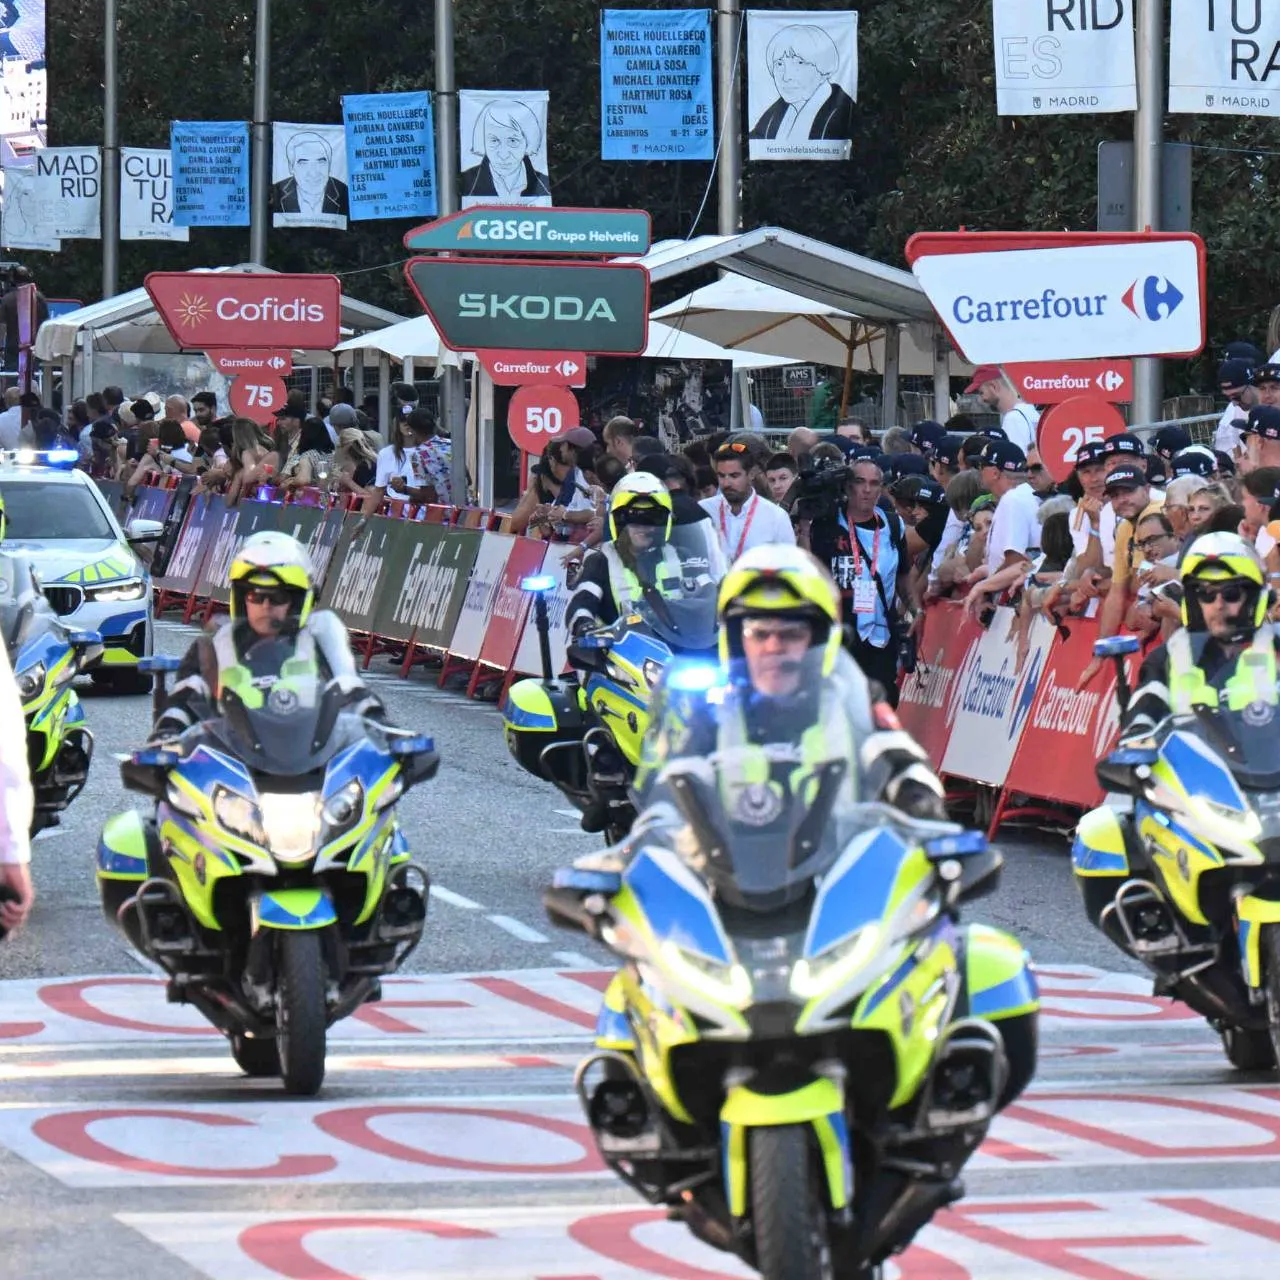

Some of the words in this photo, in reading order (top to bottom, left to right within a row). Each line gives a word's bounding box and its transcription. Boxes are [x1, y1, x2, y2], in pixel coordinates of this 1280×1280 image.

[606, 29, 642, 41] MICHEL
[643, 29, 706, 43] HOUELLEBECQ
[612, 44, 654, 56] ADRIANA
[655, 44, 701, 56] CAVARERO
[1000, 34, 1063, 80] ES
[626, 59, 662, 71] CAMILA
[664, 59, 687, 71] SOSA
[613, 74, 655, 86] MICHAEL
[656, 74, 701, 86] IGNATIEFF
[622, 89, 666, 101] HARTMUT
[669, 89, 692, 101] ROSA
[1048, 95, 1100, 108] MADRID
[1221, 95, 1270, 109] MADRID
[606, 104, 648, 115] FESTIVAL
[696, 104, 708, 115] DE
[606, 115, 624, 126] LAS
[681, 115, 708, 126] IDEAS
[644, 144, 685, 154] MADRID
[37, 154, 99, 176] MAD
[124, 156, 173, 179] CUL
[61, 177, 99, 198] RID
[132, 178, 167, 201] TU
[474, 219, 548, 241] caser
[547, 230, 586, 243] Grupo
[589, 231, 639, 243] Helvetia
[216, 296, 325, 322] Cofidis
[952, 289, 1108, 326] Carrefour
[220, 358, 265, 368] Carrefour
[493, 361, 551, 374] Carrefour
[1023, 375, 1092, 391] Carrefour
[244, 384, 273, 408] 75
[525, 406, 563, 434] 50
[1062, 425, 1105, 463] 25
[962, 653, 1018, 720] Carrefour
